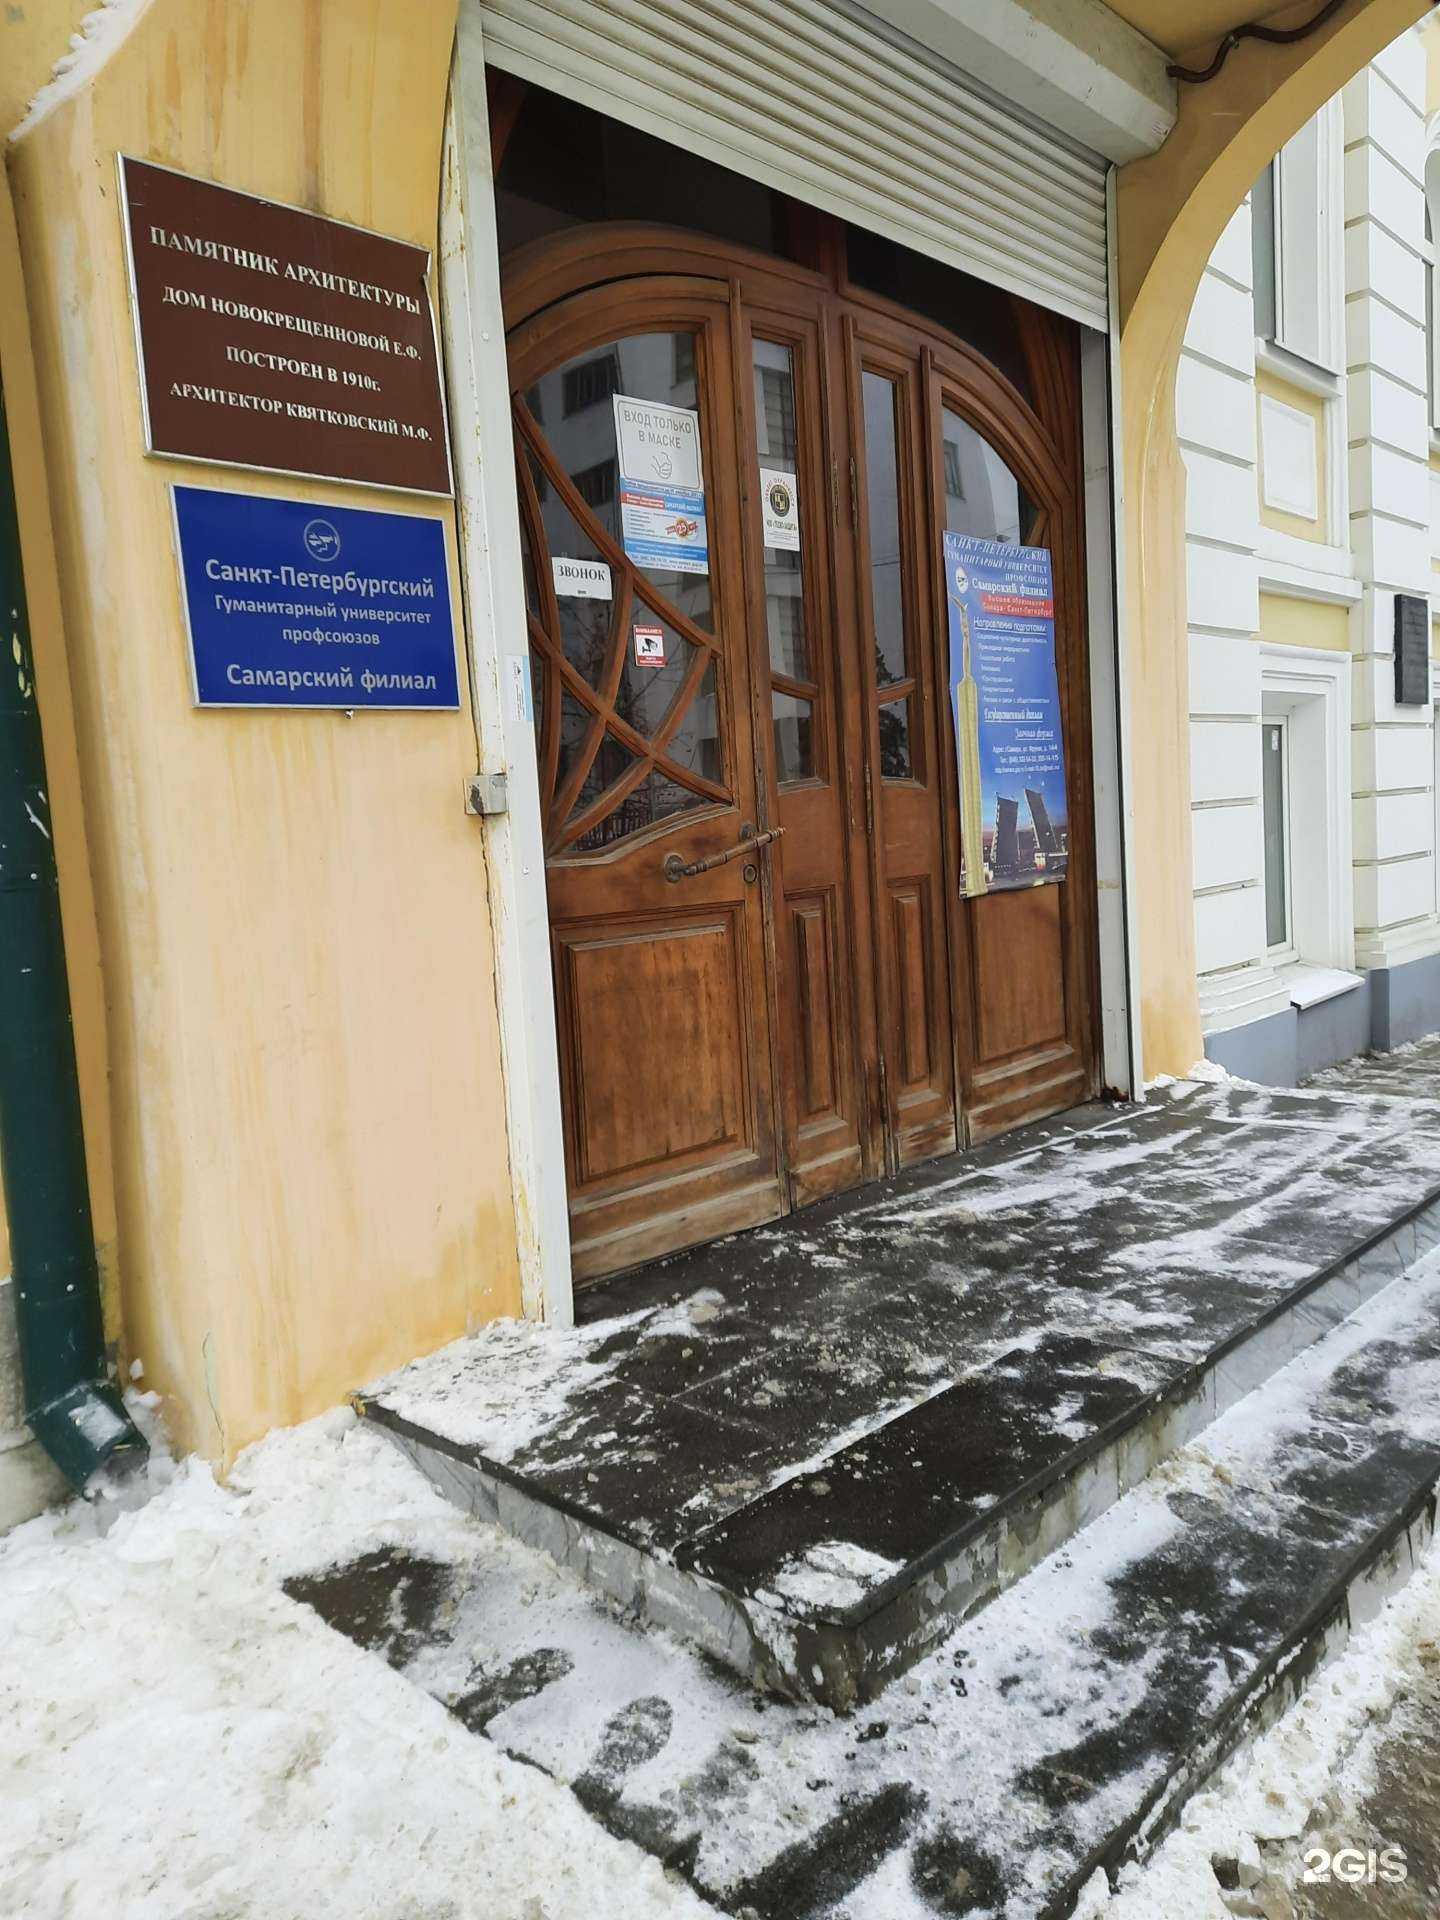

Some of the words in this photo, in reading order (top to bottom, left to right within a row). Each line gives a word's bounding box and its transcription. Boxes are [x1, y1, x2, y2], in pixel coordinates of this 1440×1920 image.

[150, 226, 279, 275] ПАМЯТНИК
[284, 263, 421, 315] АРХИТЕКТУРЫ
[162, 286, 206, 309] ДОМ
[211, 298, 390, 353] НОВОКРЕЩЕННОВОЙ
[393, 341, 422, 360] Е.Ф.
[226, 345, 323, 380] ПОСТРОЕН
[327, 368, 338, 382] В
[342, 370, 381, 392] 1910г.
[170, 382, 282, 413] АРХИТЕКТОР
[286, 402, 399, 436] КВЯТКОВСКИЙ
[401, 424, 433, 441] М.Ф.
[624, 410, 651, 428] ВХОД
[653, 415, 691, 433] ТОЛЬКО
[638, 430, 645, 442] В
[648, 432, 681, 449] МАСКЕ
[205, 558, 434, 598] Санкт-Петербургский
[559, 565, 605, 581] ЗВОНОК
[972, 578, 1018, 594] Самарский
[1019, 583, 1048, 597] филиал
[215, 594, 337, 619] Гуманитарный
[341, 606, 431, 624] университет
[282, 628, 380, 645] профсоюзов
[226, 663, 354, 690] Самарский
[360, 668, 437, 693] филиал
